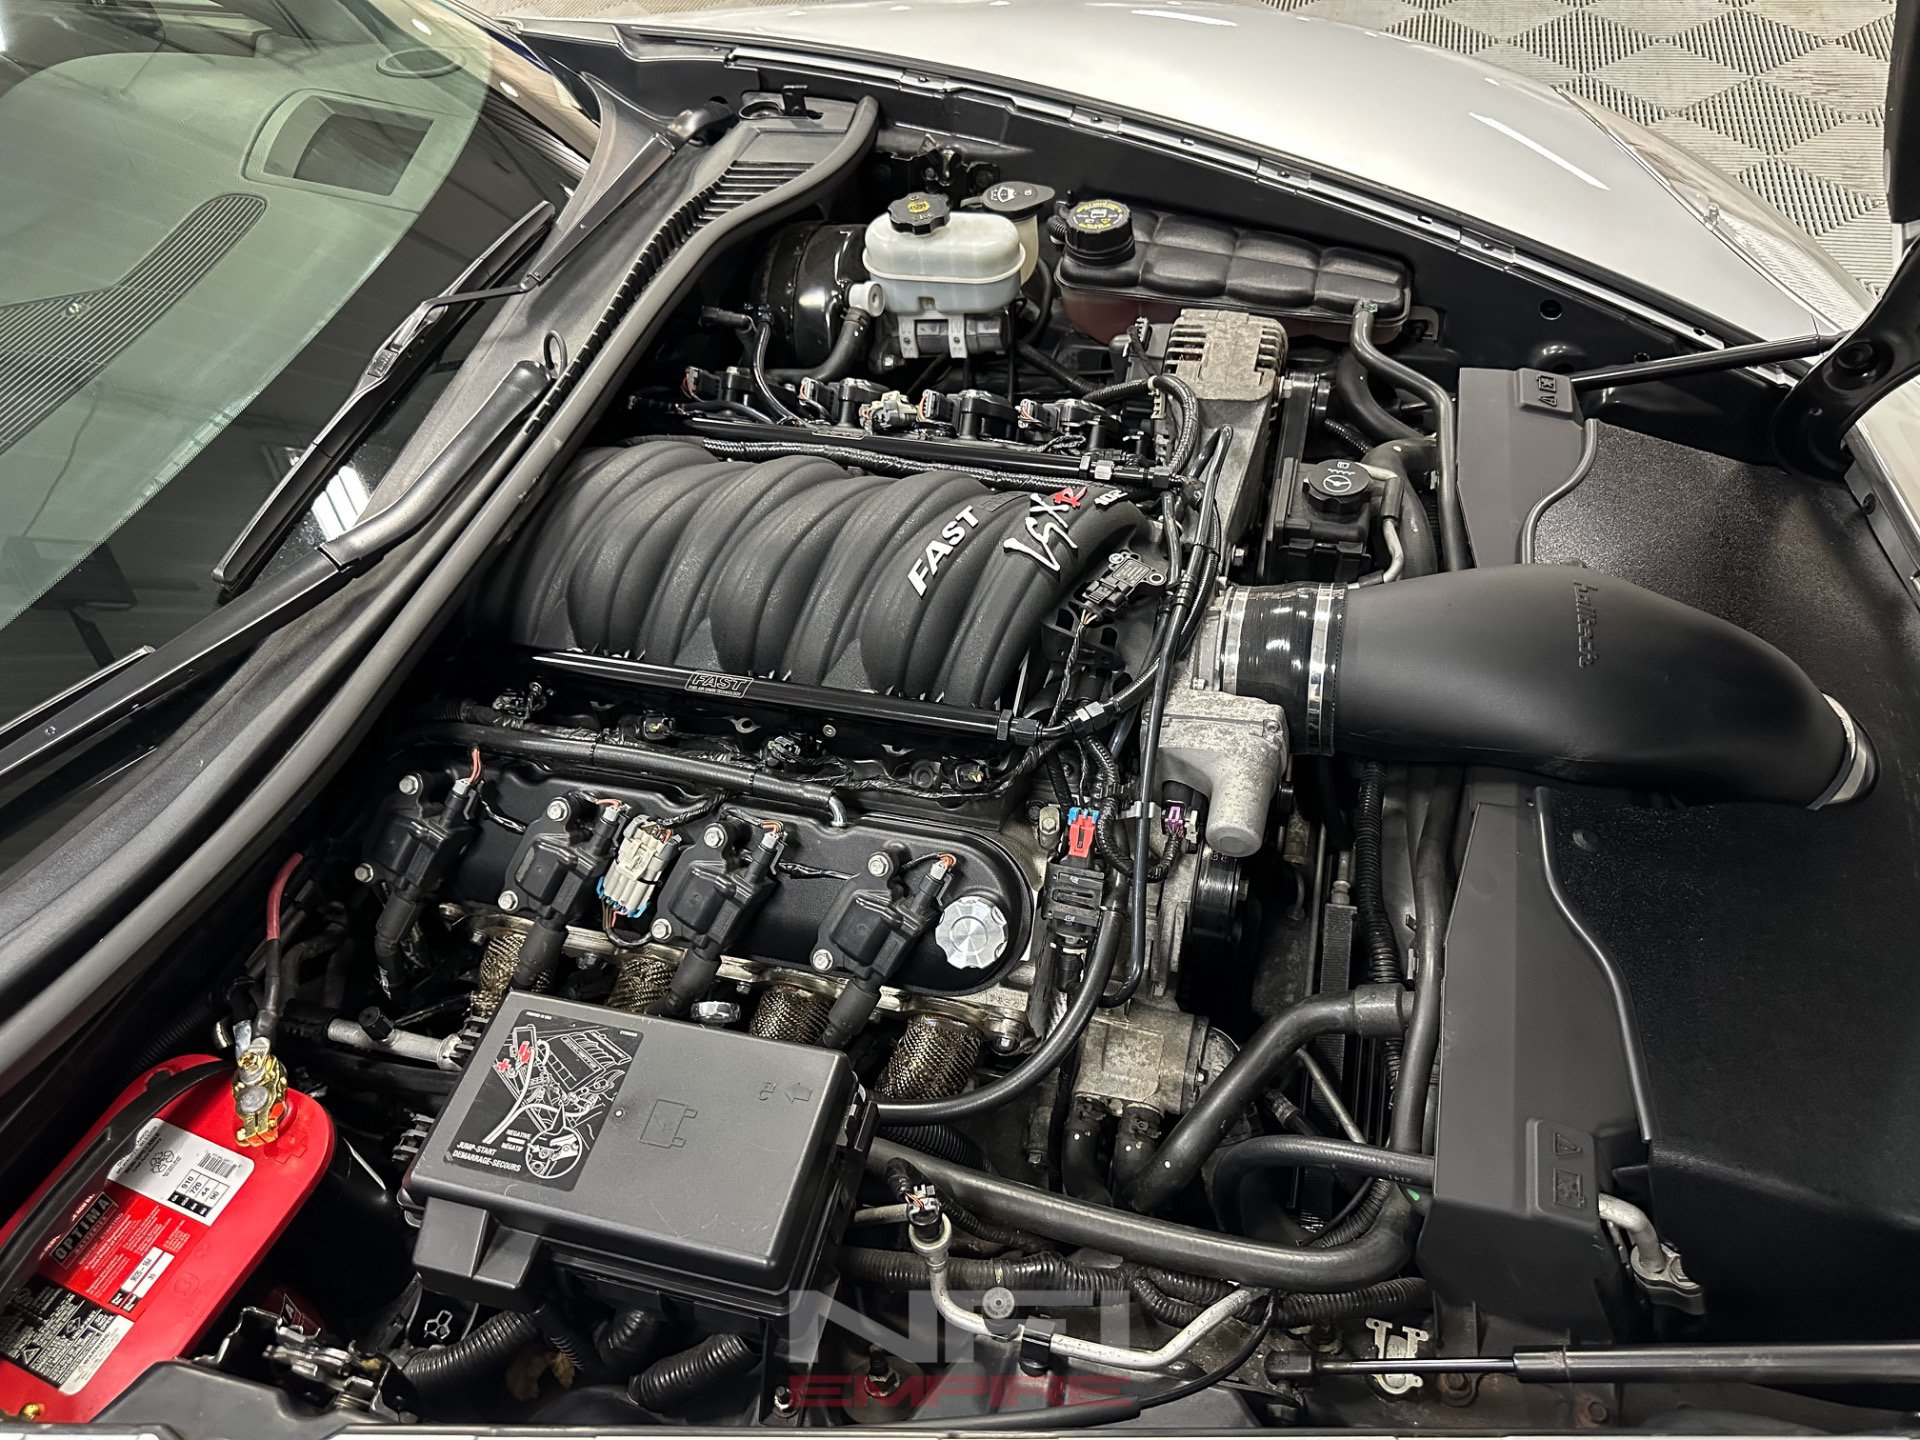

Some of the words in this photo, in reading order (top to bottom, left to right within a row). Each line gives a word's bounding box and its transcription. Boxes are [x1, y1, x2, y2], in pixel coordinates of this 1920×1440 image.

[1094, 489, 1129, 506] 102
[907, 505, 979, 597] FAST
[692, 673, 748, 691] FAST
[505, 1129, 531, 1140] NEGATIVE
[456, 1142, 498, 1156] JUMP-START
[181, 1175, 194, 1190] 910
[190, 1181, 202, 1195] 720
[200, 1187, 210, 1197] 44
[209, 1190, 220, 1201] 90
[54, 1196, 111, 1261] OPTIMA
